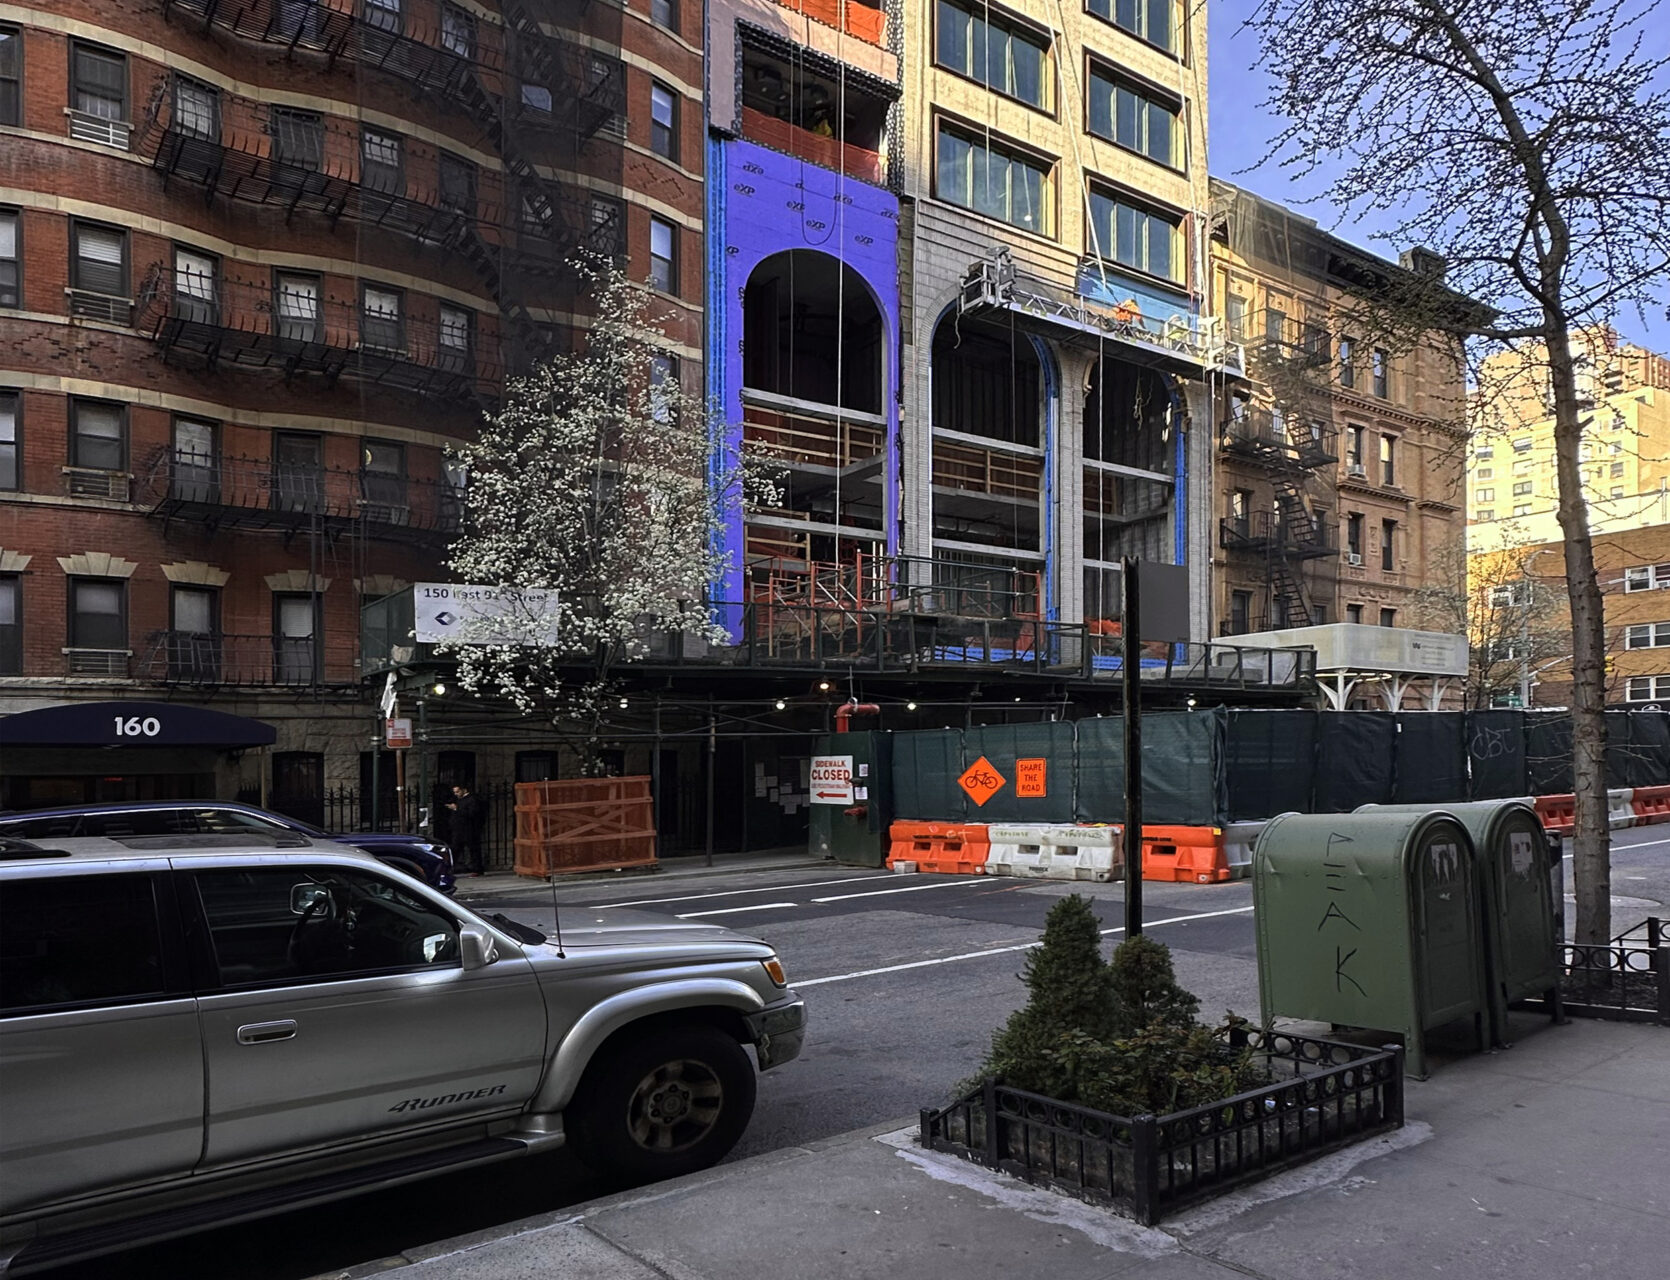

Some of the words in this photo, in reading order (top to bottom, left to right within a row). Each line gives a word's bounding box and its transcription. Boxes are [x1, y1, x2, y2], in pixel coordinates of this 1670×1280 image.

[733, 183, 756, 195] eXP
[806, 220, 826, 231] eXP
[854, 235, 874, 246] eXP
[424, 588, 449, 598] 150
[114, 716, 161, 736] 160
[1020, 763, 1042, 772] SHARE
[811, 769, 851, 781] CLOSED
[1024, 773, 1038, 782] THE
[1021, 784, 1041, 792] ROAD
[1317, 832, 1369, 998] PEAK
